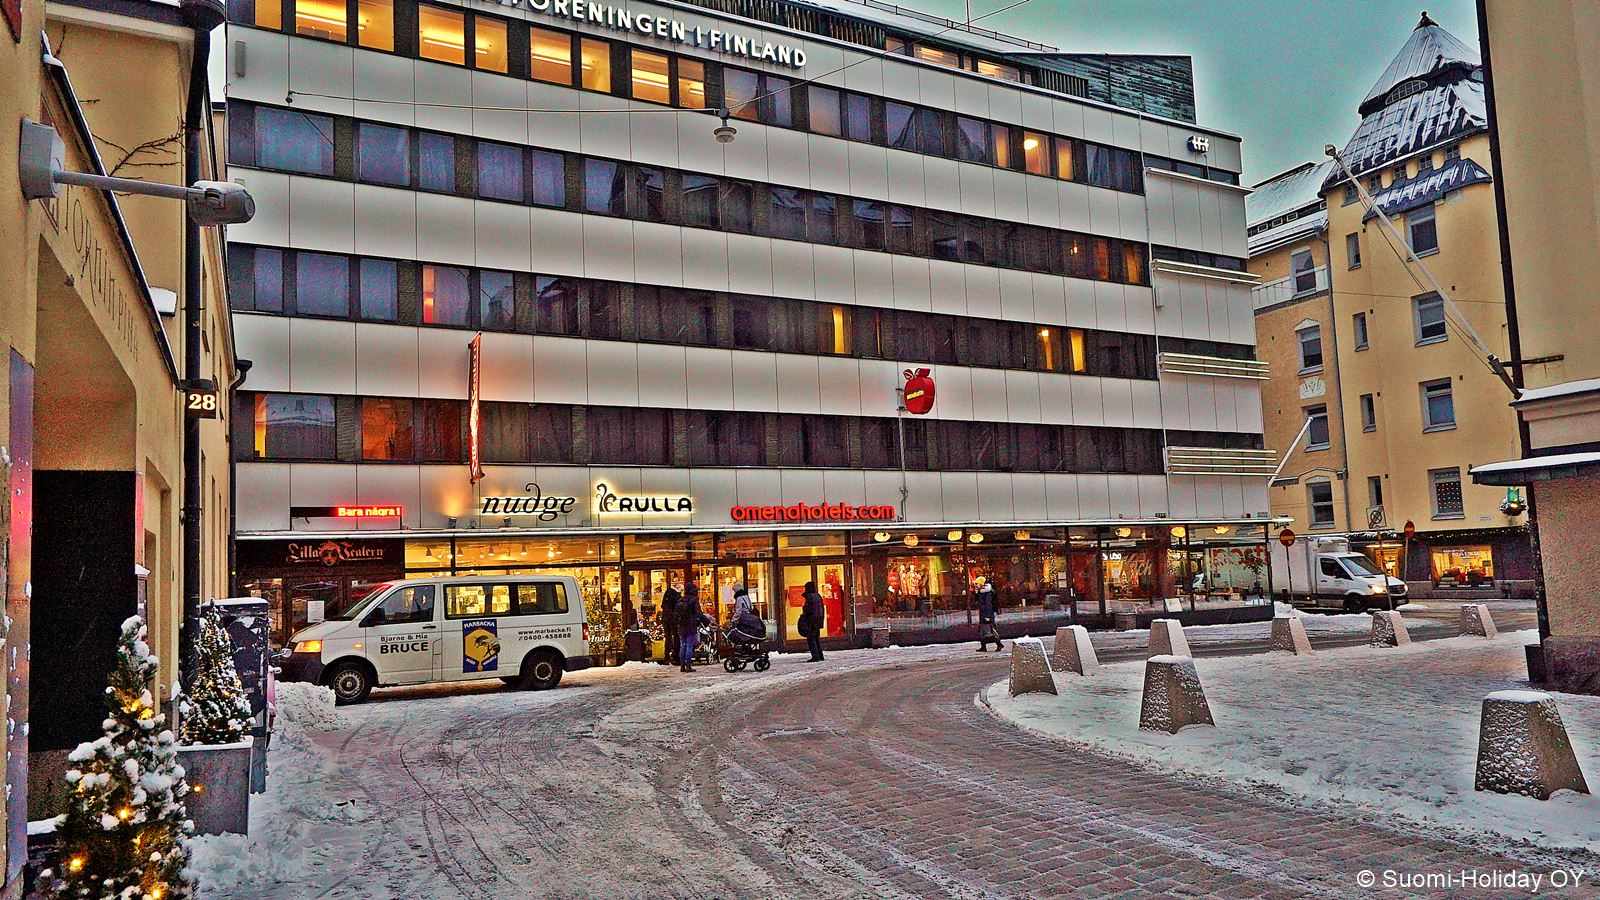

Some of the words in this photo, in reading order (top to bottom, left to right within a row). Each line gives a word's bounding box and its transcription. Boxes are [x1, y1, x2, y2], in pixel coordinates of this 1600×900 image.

[512, 0, 686, 40] RENINGEN
[711, 30, 807, 67] FINLAND
[188, 394, 216, 410] 28
[482, 483, 576, 521] nudge
[338, 507, 363, 516] Bara
[731, 502, 895, 520] omenahotels.com
[518, 627, 571, 635] www.marbacka.fi
[380, 642, 429, 654] BRUCE
